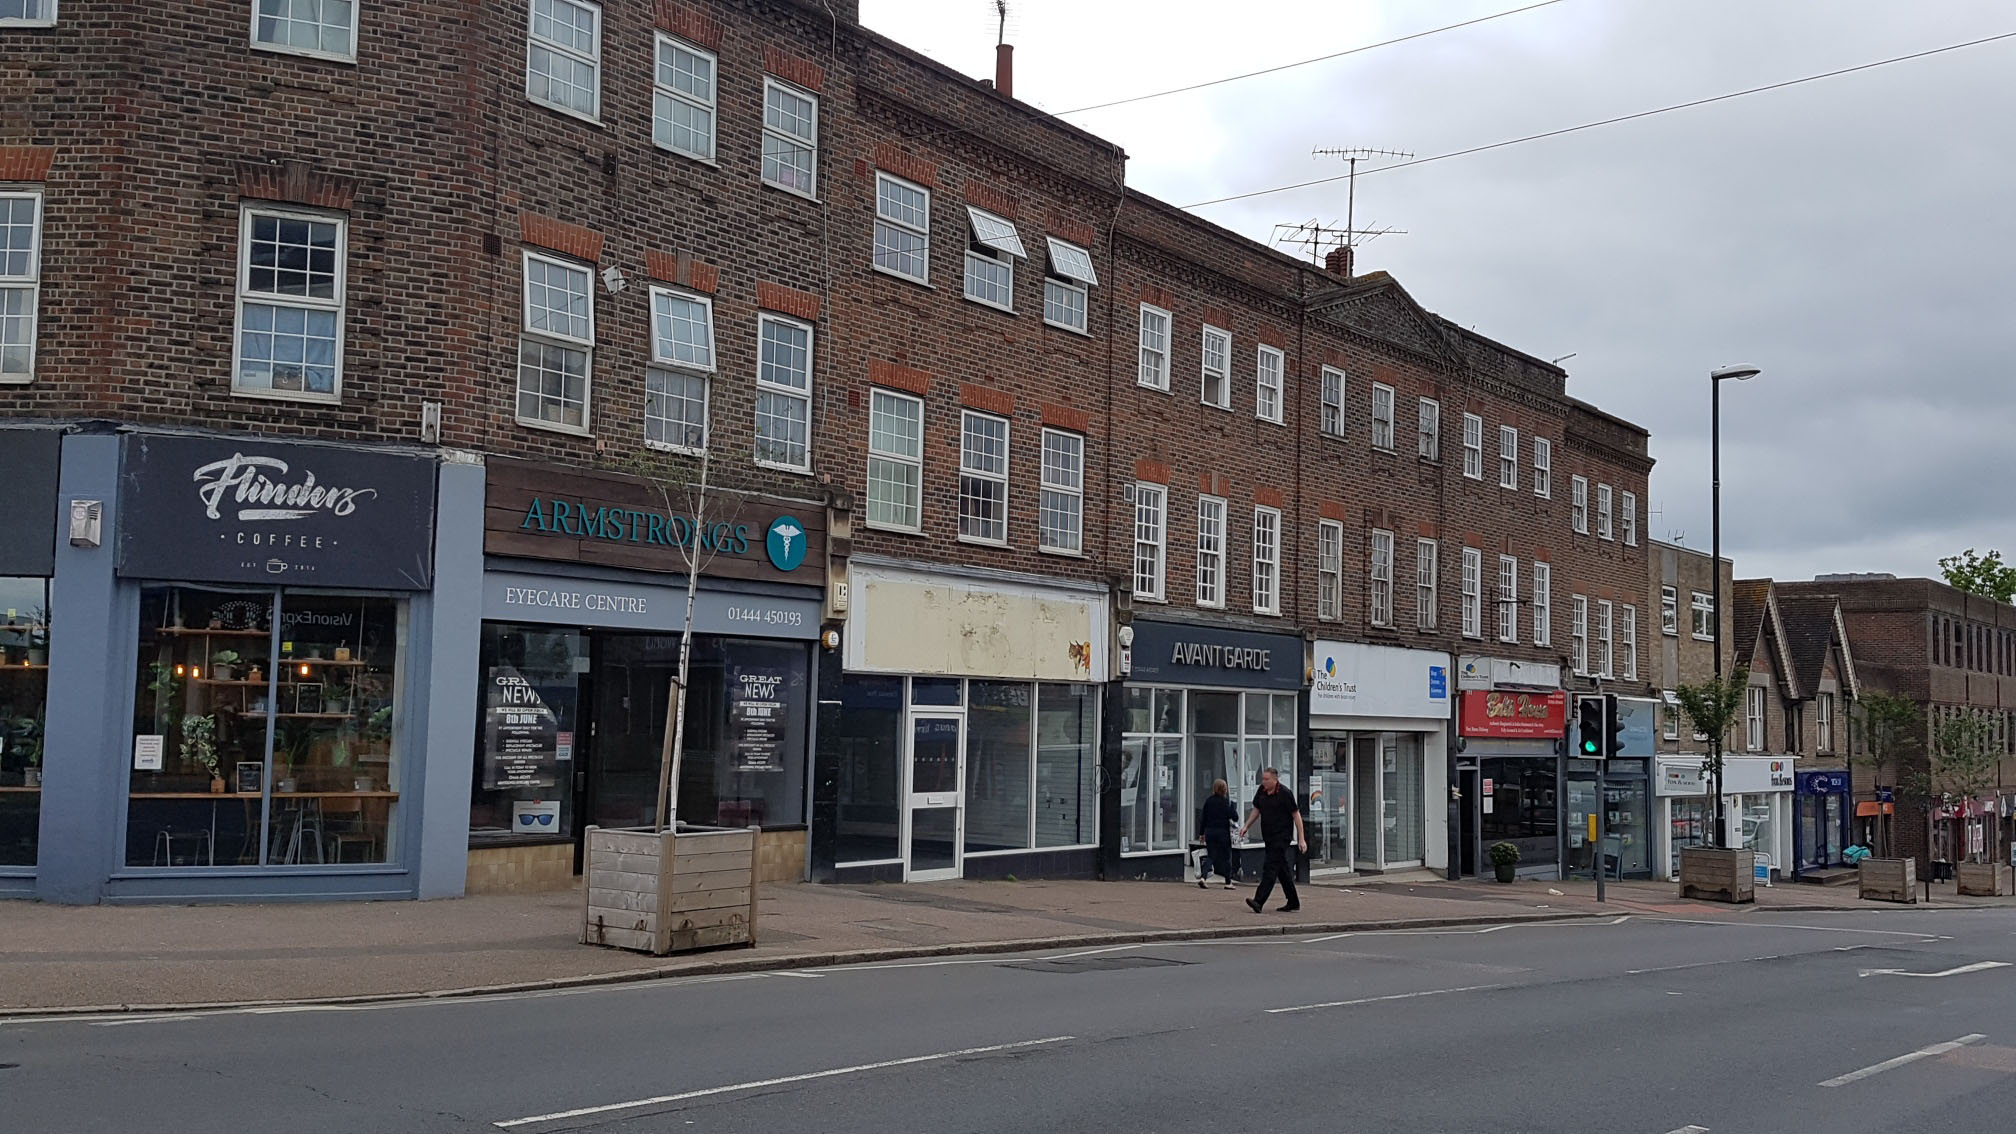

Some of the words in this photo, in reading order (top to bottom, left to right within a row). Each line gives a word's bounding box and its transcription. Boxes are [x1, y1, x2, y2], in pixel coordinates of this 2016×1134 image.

[193, 452, 377, 519] Flinders
[520, 497, 748, 554] ARMSTRONGS
[237, 532, 323, 548] COFFEE
[506, 587, 580, 608] EYECARE
[585, 594, 647, 613] CENTRE
[728, 607, 760, 622] 01444
[764, 610, 802, 626] 450193
[1171, 642, 1222, 667] AVANT
[1224, 646, 1271, 671] GARDE
[740, 674, 782, 684] GREAT
[1317, 669, 1328, 680] The
[745, 683, 775, 699] NEWS
[1317, 681, 1342, 692] Children's
[1344, 683, 1357, 692] Trust
[519, 714, 538, 724] JUNE
